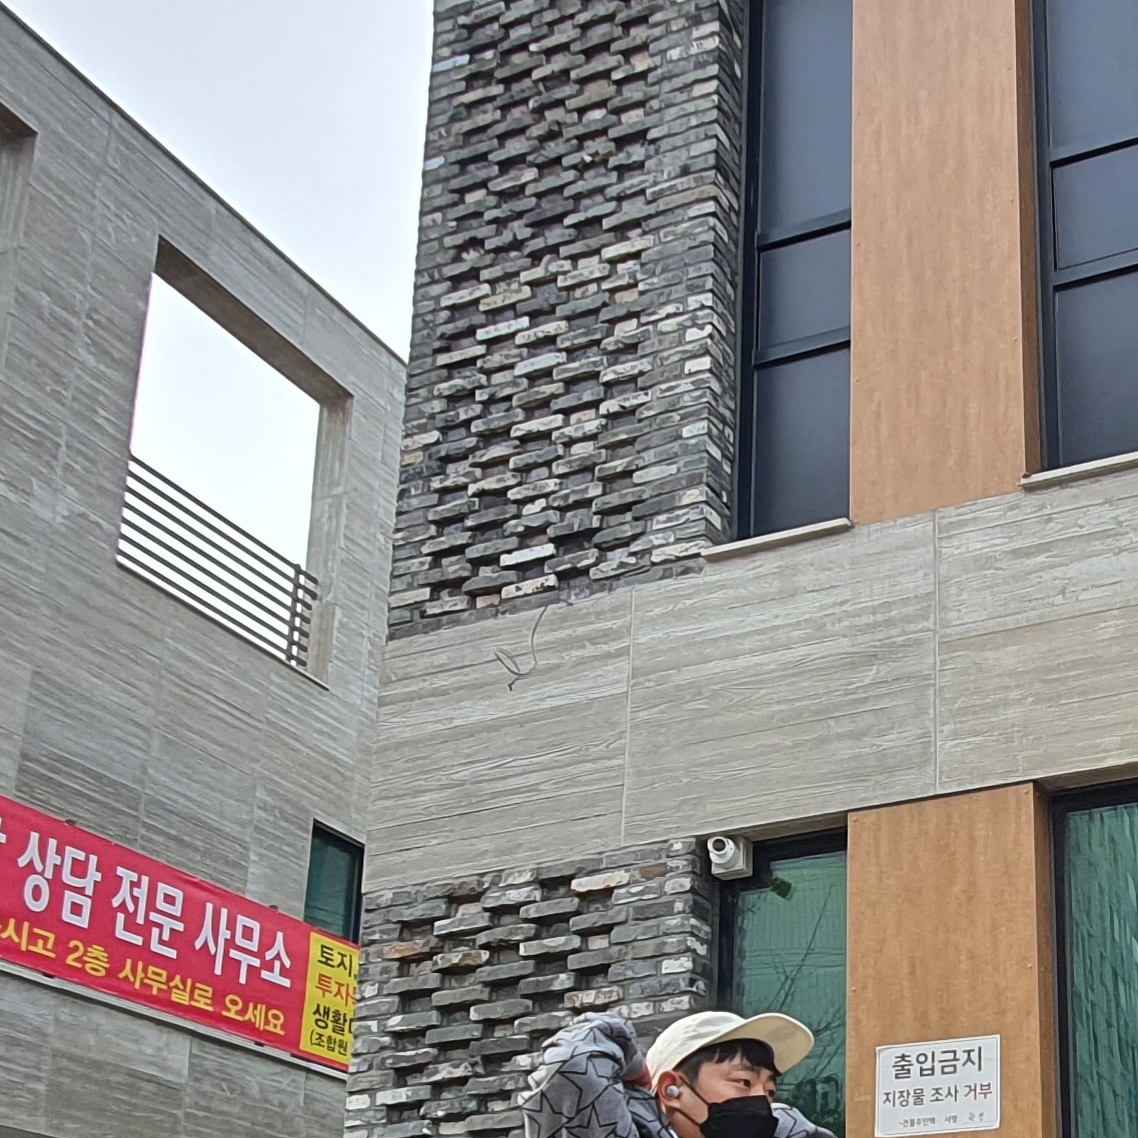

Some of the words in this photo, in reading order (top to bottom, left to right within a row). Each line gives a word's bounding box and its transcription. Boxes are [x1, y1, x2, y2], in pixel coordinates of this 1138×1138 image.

[17, 831, 102, 930] 상담
[112, 866, 185, 960] 전문
[194, 901, 292, 989] 사무소
[65, 939, 111, 978] 2층
[118, 957, 215, 1013] 사무실로
[221, 993, 286, 1037] 오세요
[882, 1087, 926, 1108] 지장물
[929, 1084, 959, 1103] 조사
[964, 1081, 993, 1101] 거부
[891, 1045, 983, 1080] 출입금지
